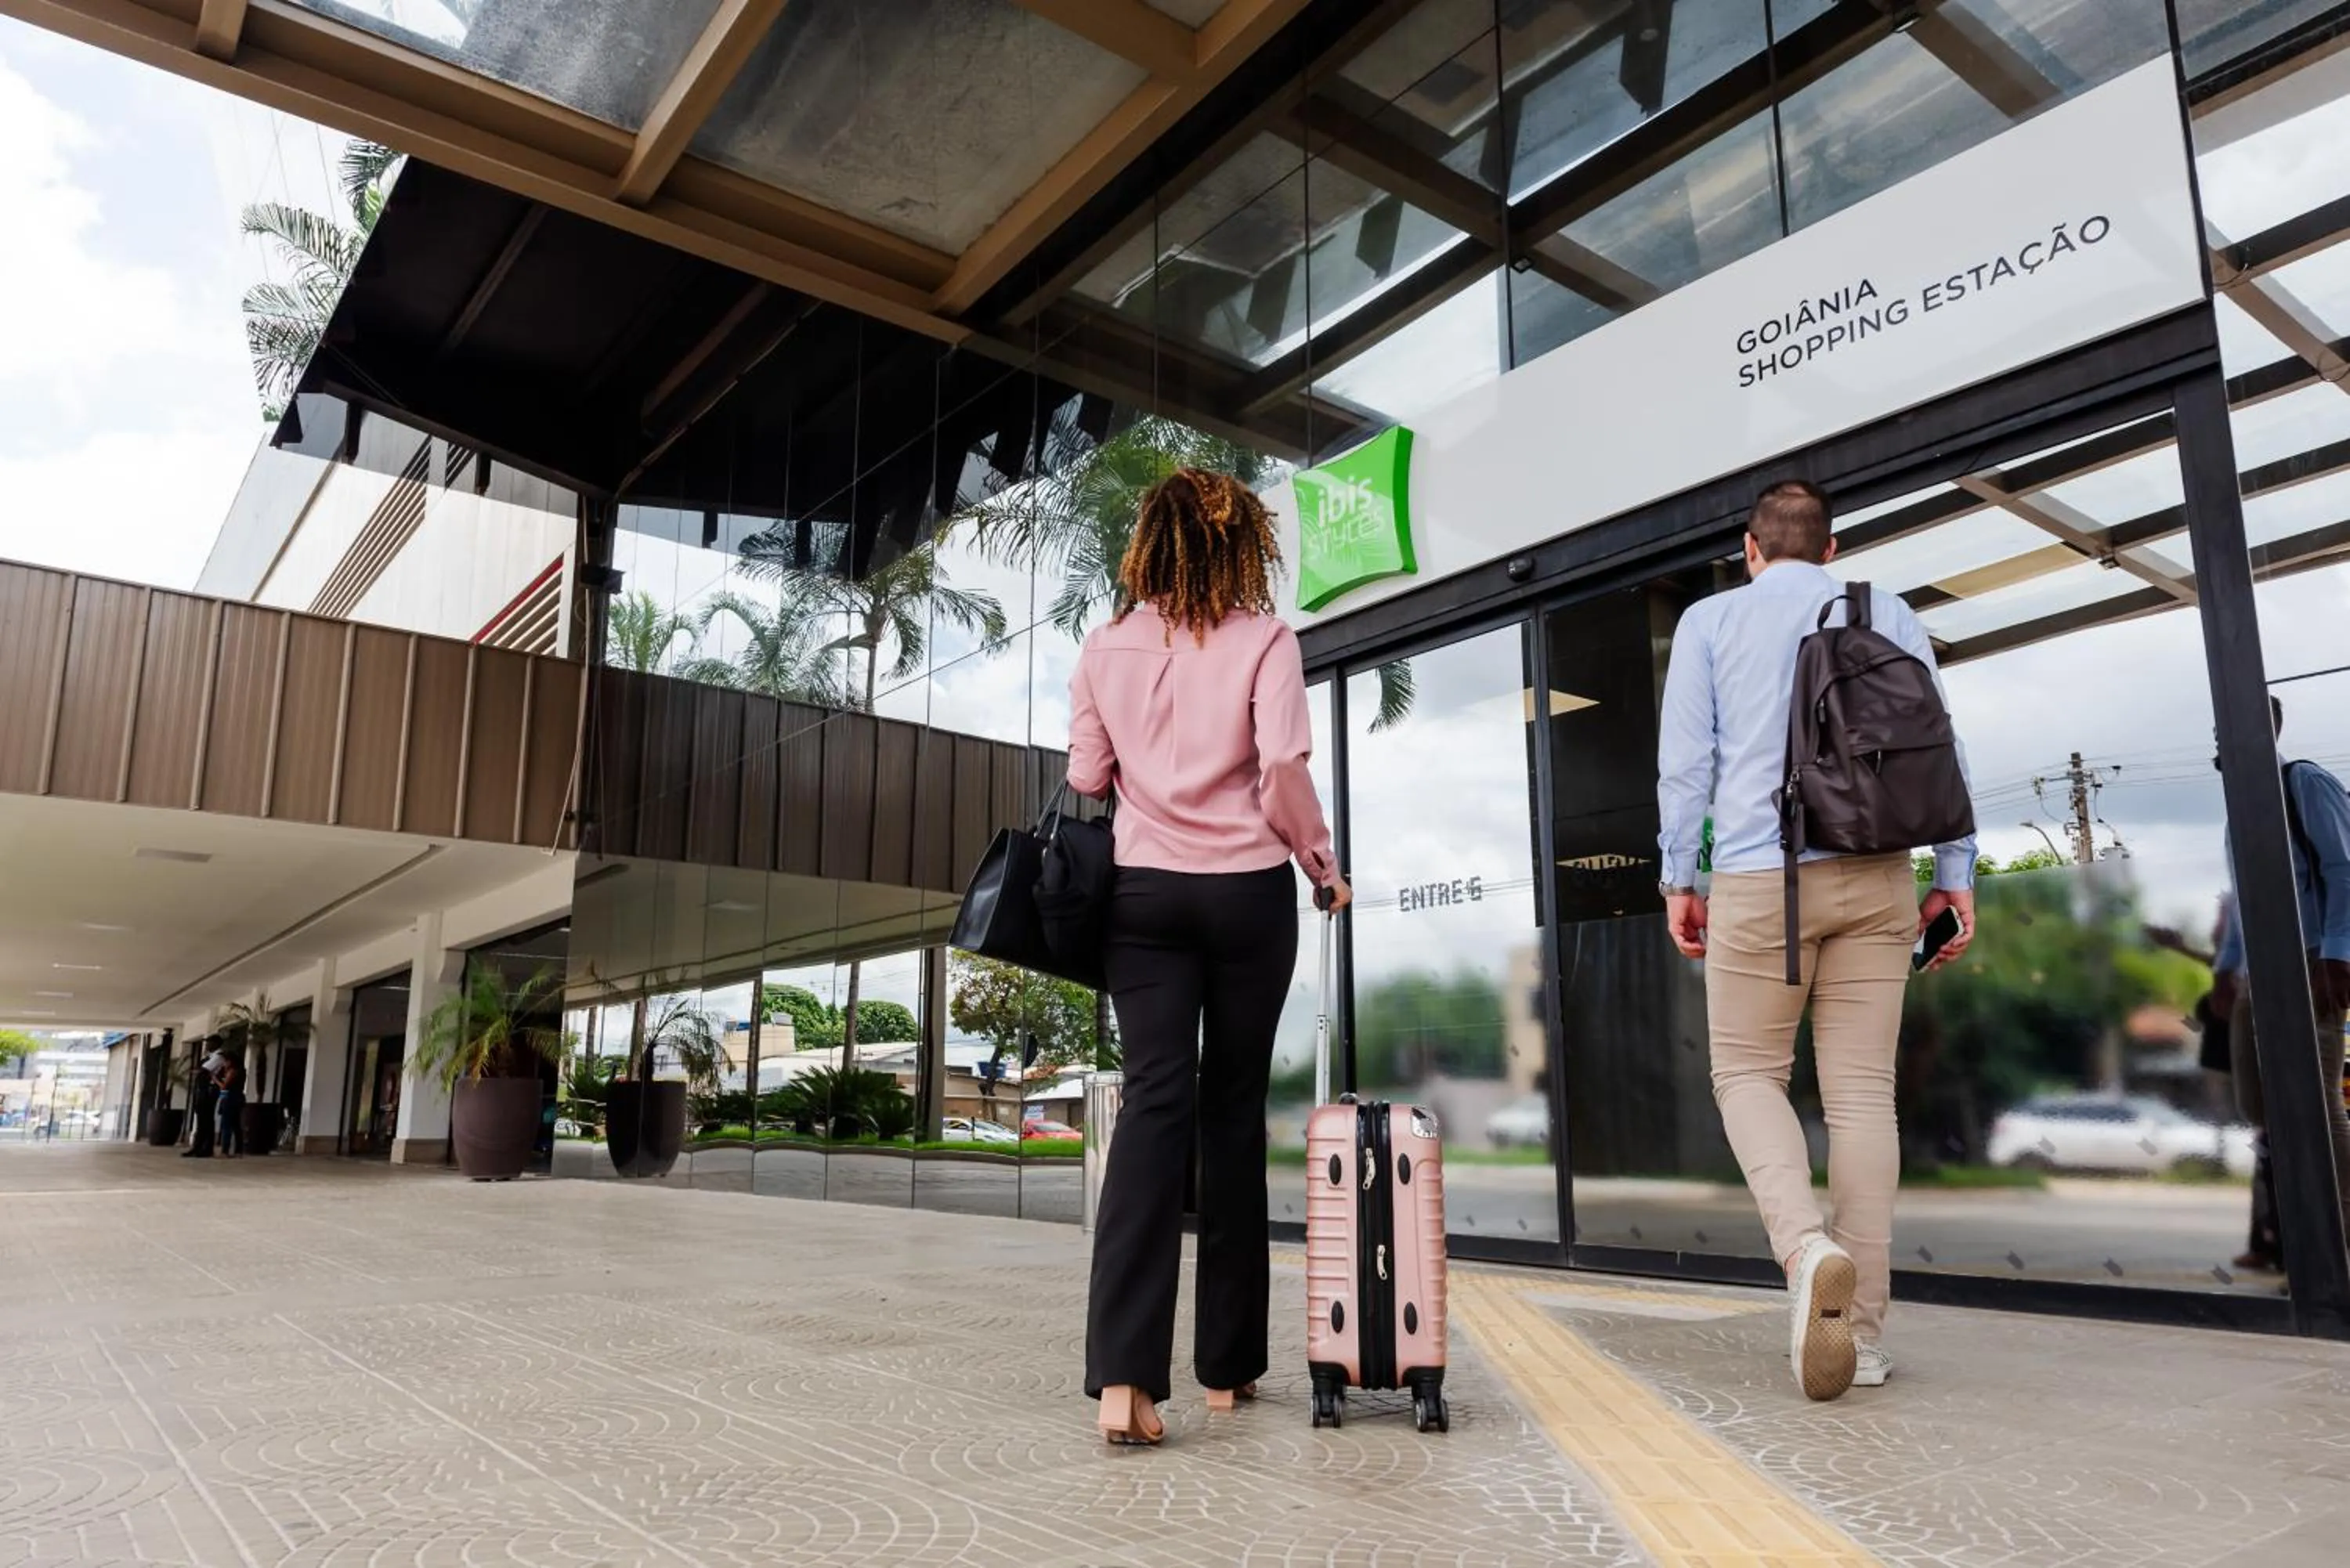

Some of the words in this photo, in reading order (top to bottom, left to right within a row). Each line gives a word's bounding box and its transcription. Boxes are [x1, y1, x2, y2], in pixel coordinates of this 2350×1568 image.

[1737, 278, 1878, 354] GOIÂNIA
[1738, 298, 1909, 387] SHOPPING
[1922, 215, 2111, 312] ESTAÇÃO
[1318, 475, 1373, 527] ibis
